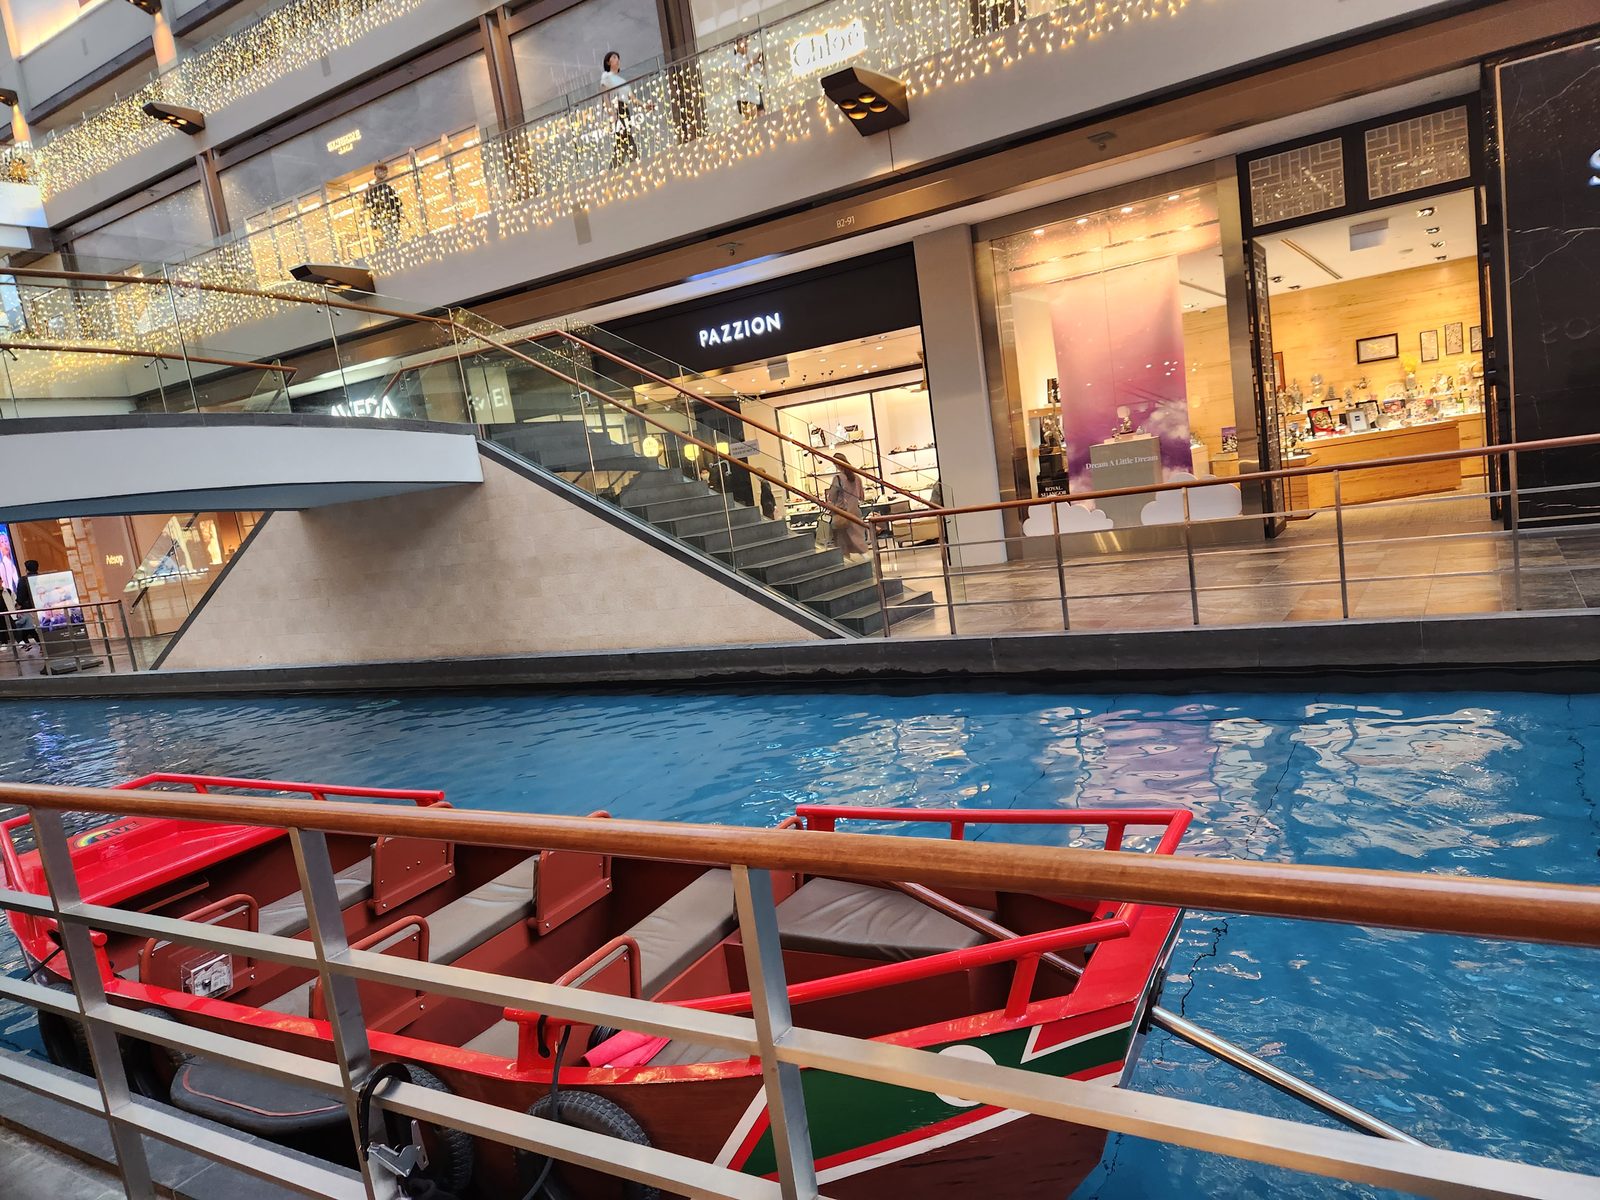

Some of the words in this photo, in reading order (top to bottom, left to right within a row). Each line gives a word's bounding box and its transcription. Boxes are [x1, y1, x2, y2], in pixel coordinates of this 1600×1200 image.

[792, 21, 861, 69] Chloé
[698, 312, 781, 348] PAZZION
[1085, 461, 1109, 470] Dream
[1115, 457, 1134, 466] Little
[1134, 455, 1159, 464] Dream
